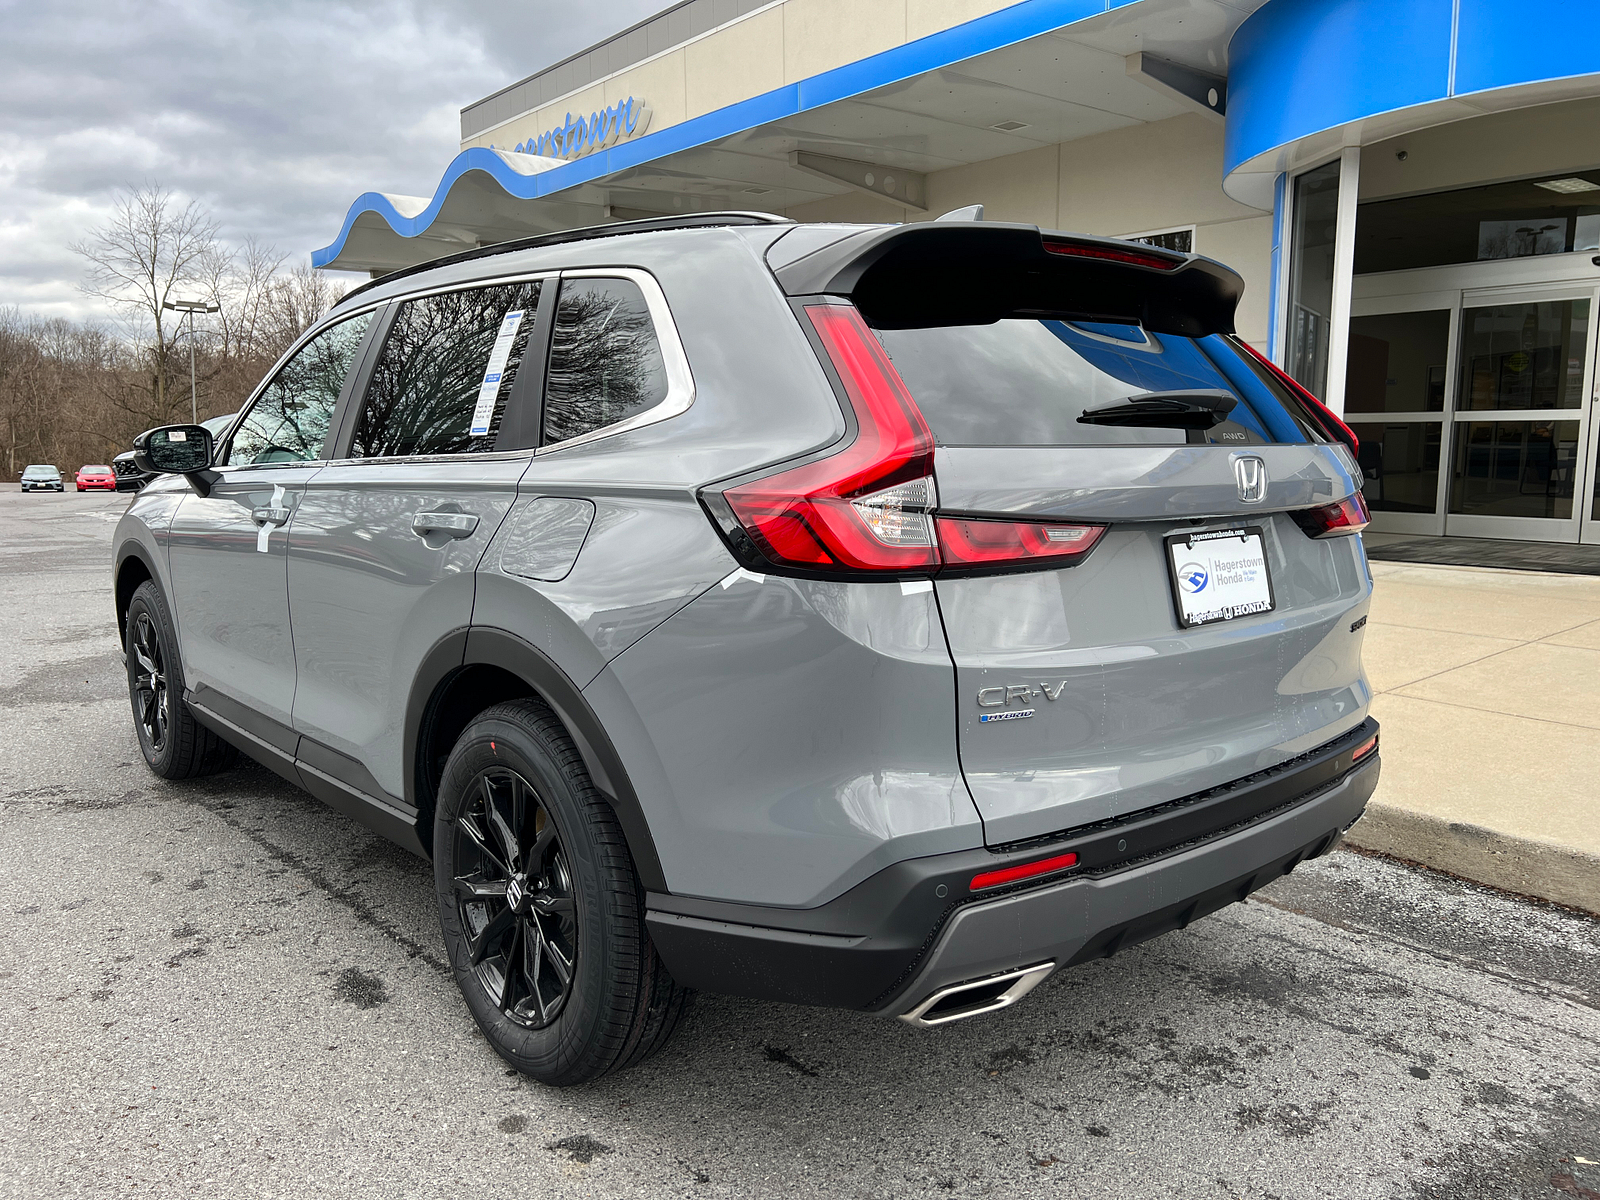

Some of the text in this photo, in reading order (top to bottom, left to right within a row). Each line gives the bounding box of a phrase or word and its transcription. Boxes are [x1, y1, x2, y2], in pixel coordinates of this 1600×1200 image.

[490, 96, 641, 158] erstown
[1222, 432, 1246, 440] AWD
[1214, 557, 1263, 573] Hagerstown
[1216, 572, 1243, 586] Honda
[1233, 601, 1272, 616] HONDA
[977, 680, 1067, 707] CR-V
[988, 711, 1033, 721] HYBRID
